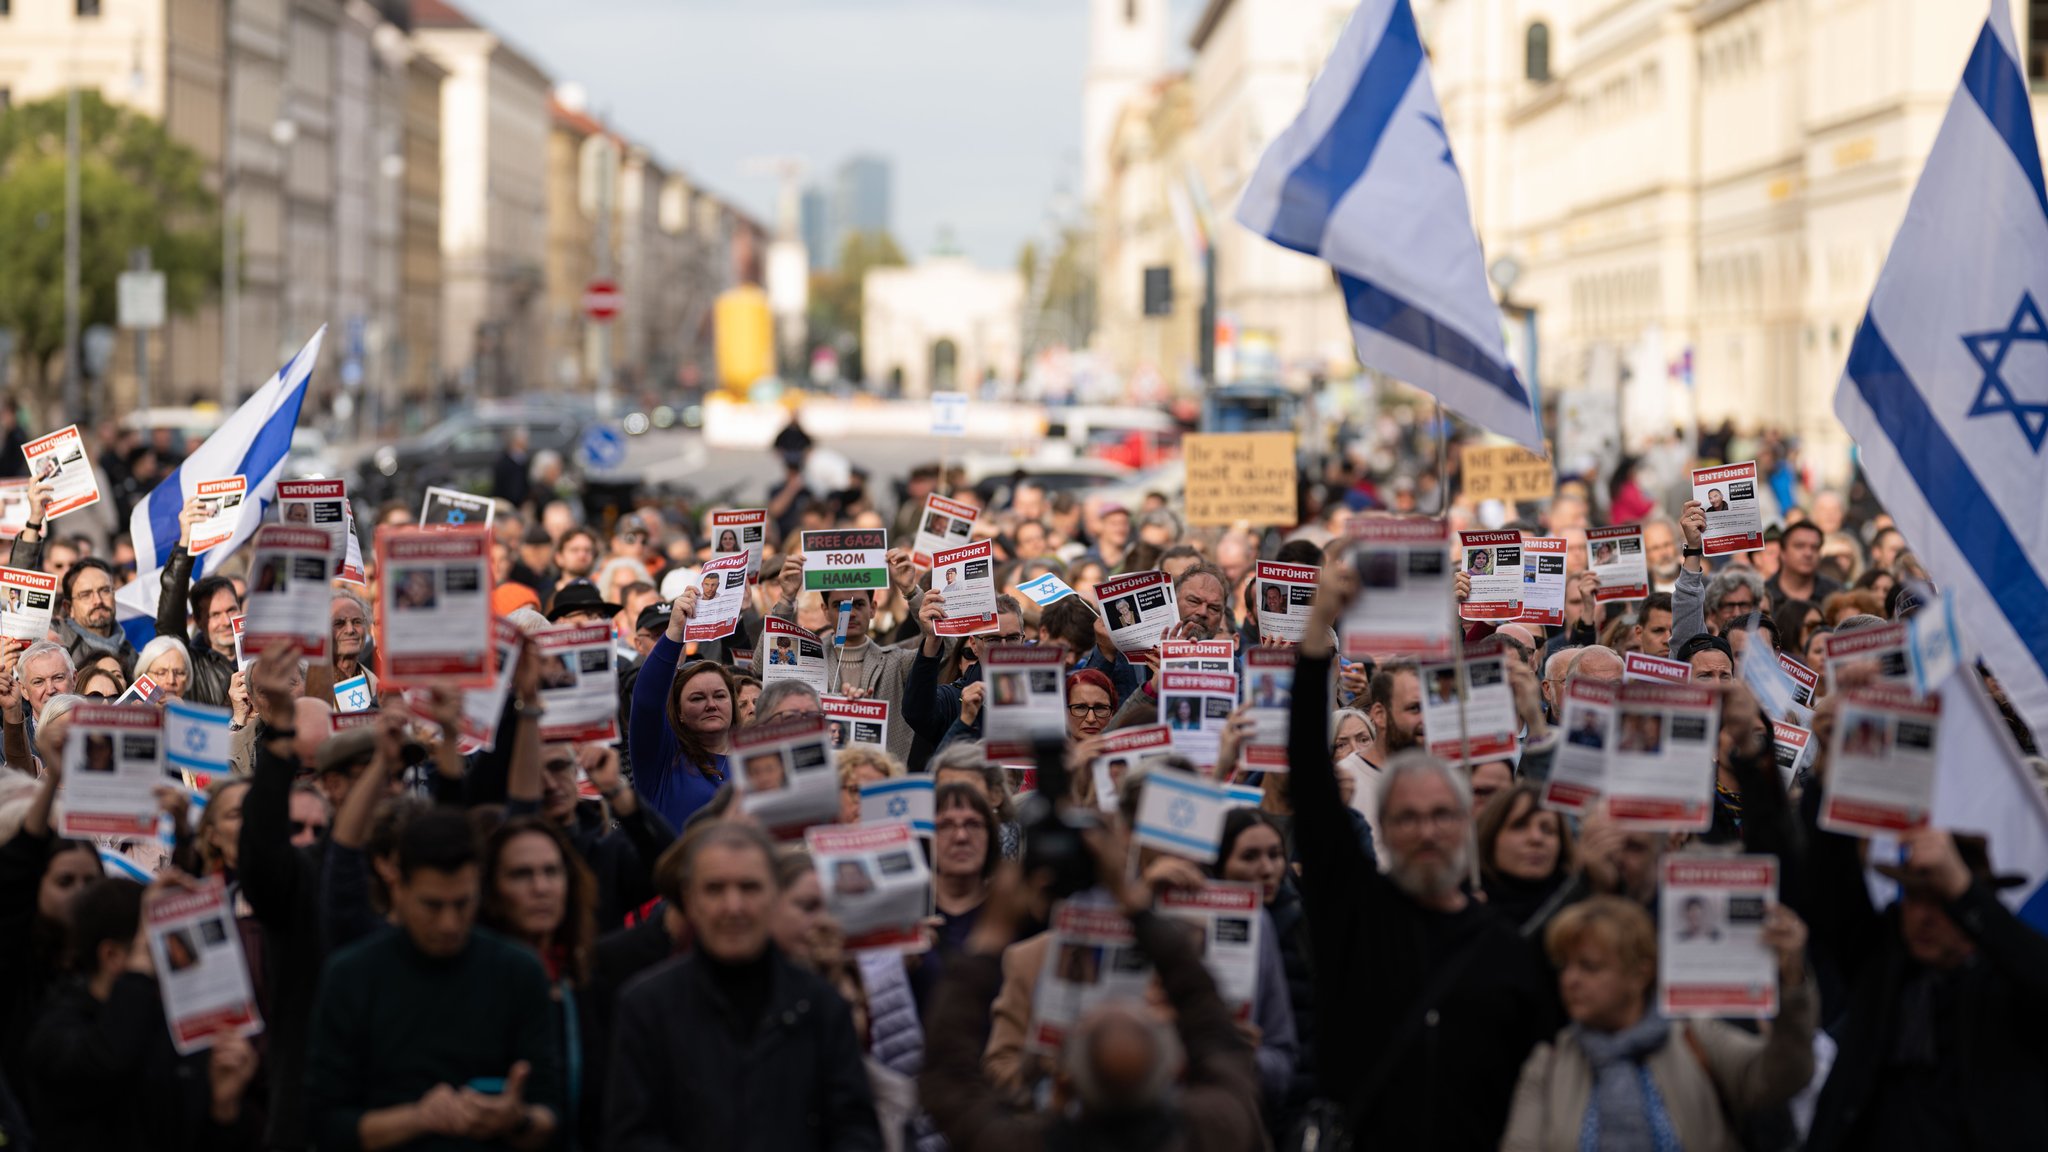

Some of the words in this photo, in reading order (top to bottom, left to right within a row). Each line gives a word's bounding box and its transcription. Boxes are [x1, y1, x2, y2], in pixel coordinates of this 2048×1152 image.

[1698, 467, 1751, 483] ENTFÜHRT
[200, 480, 242, 493] ENTFÜHRT
[282, 484, 339, 495] ENTFÜHRT
[717, 513, 762, 523] ENTFÜHRT
[807, 535, 841, 549] FREE
[844, 534, 882, 547] GAZA
[1465, 533, 1516, 543] ENTFÜHRT
[1524, 541, 1561, 549] RMISST
[705, 554, 747, 570] ENTFÜHRT
[826, 553, 865, 565] FROM
[938, 546, 987, 564] ENTFÜHRT
[3, 571, 51, 587] ENTFÜHRT
[822, 571, 871, 585] HAMAS
[1262, 566, 1315, 580] ENTFÜHRT
[1101, 574, 1156, 596] ENTFÜHRT
[771, 621, 817, 640] ENTFÜHRT
[1168, 644, 1226, 655] ENTFÜHRT
[1632, 660, 1685, 678] ENTFÜHRT
[1781, 660, 1814, 683] ENTFÜHRT
[823, 702, 882, 716] ENTFÜHRT
[1774, 725, 1802, 742] ÜHRT
